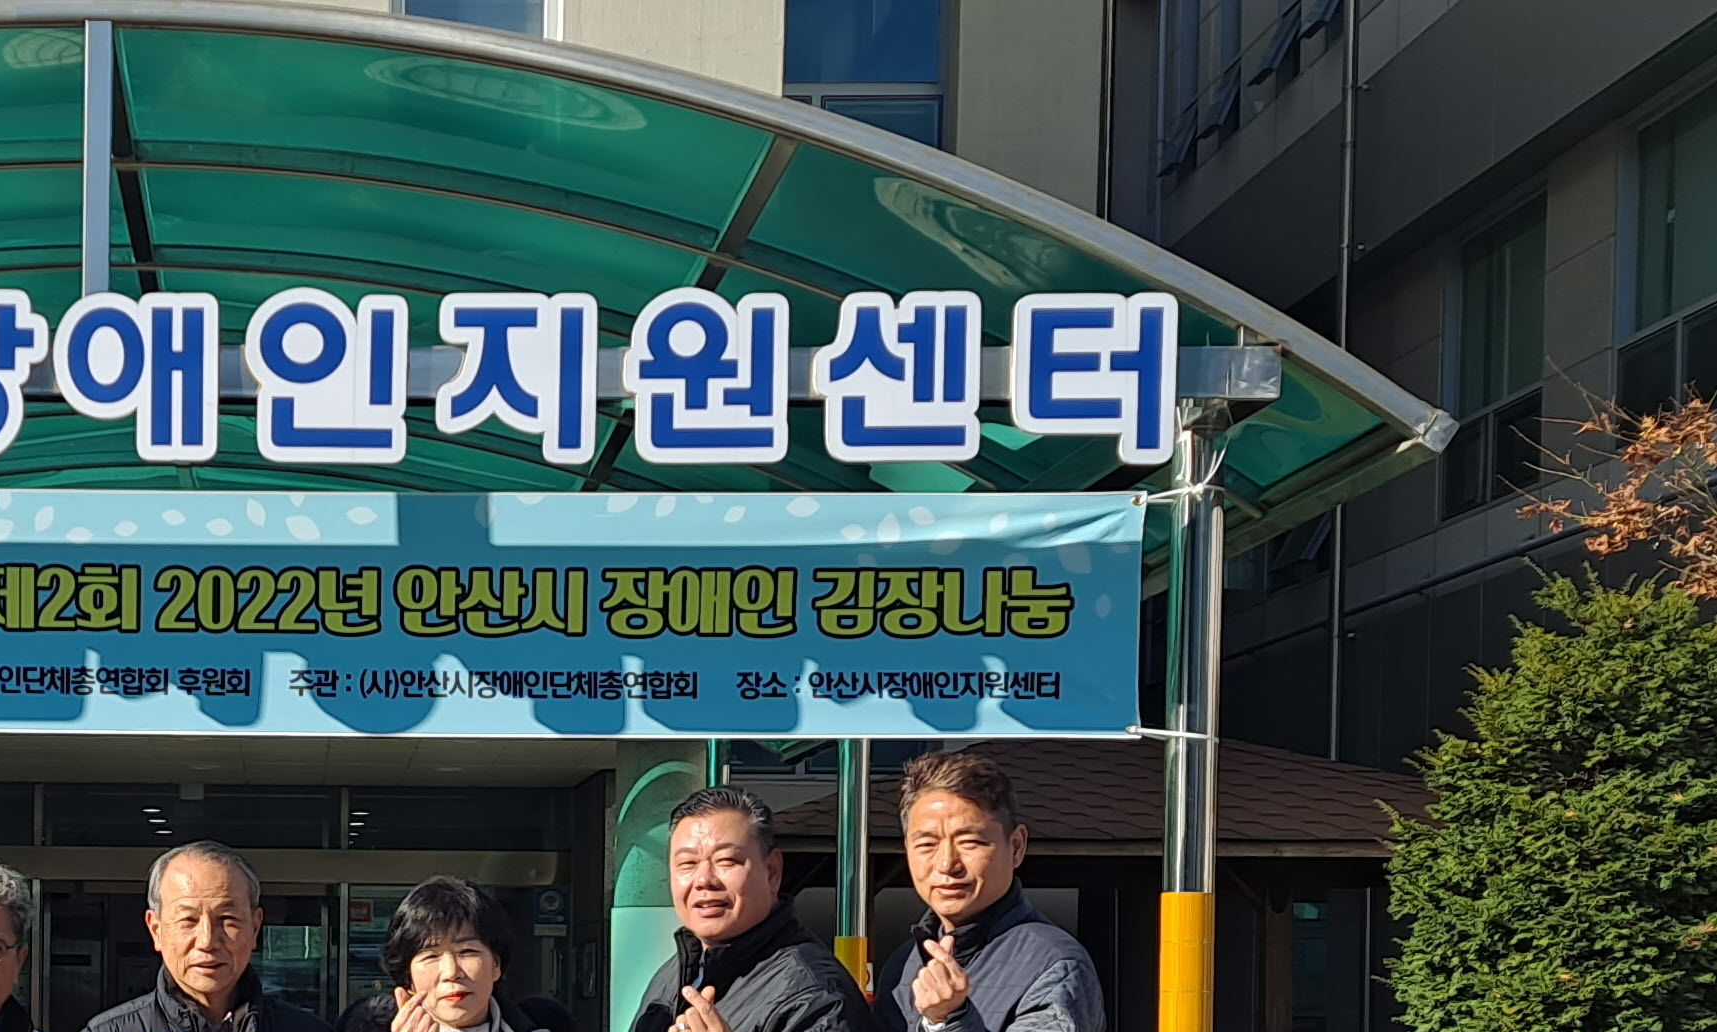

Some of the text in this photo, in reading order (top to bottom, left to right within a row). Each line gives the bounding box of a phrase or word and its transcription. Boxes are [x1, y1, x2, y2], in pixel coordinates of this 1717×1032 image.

[153, 565, 383, 638] 2022년
[393, 566, 588, 638] 안산시
[601, 566, 797, 639] 장애인
[811, 566, 1075, 639] 김장나눔
[177, 666, 251, 698] 후원회
[288, 667, 341, 699] 주관
[359, 668, 697, 700] (사)안산시장애인단체총연합회
[736, 671, 788, 700] 장소
[809, 670, 1061, 700] 안산시장애인지원센터
